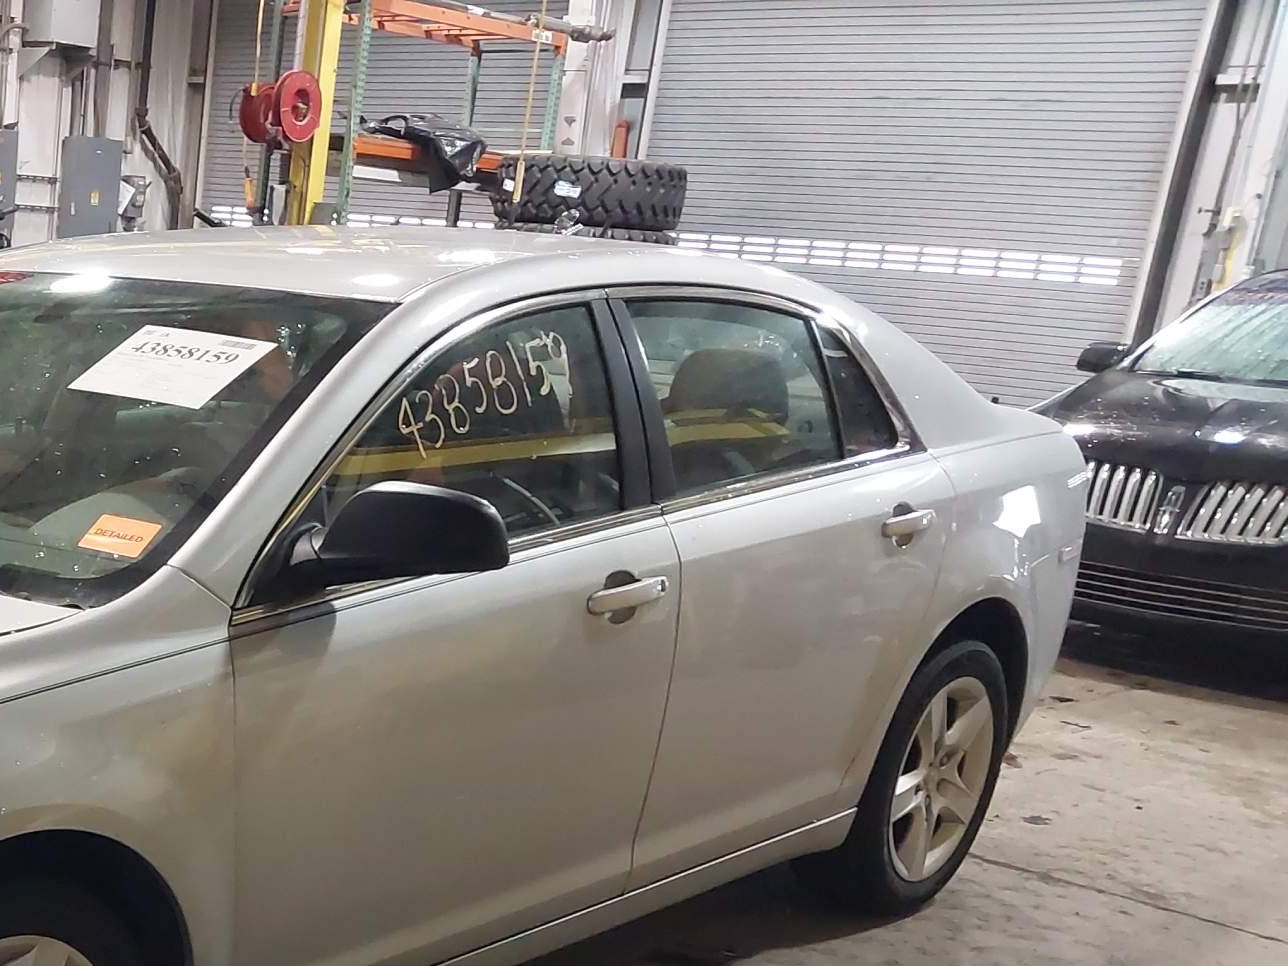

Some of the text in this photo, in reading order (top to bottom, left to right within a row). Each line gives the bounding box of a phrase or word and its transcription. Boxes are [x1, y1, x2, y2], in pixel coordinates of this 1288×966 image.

[131, 340, 241, 365] 43858159
[398, 331, 574, 459] 43858159
[94, 527, 144, 543] DETAILED
